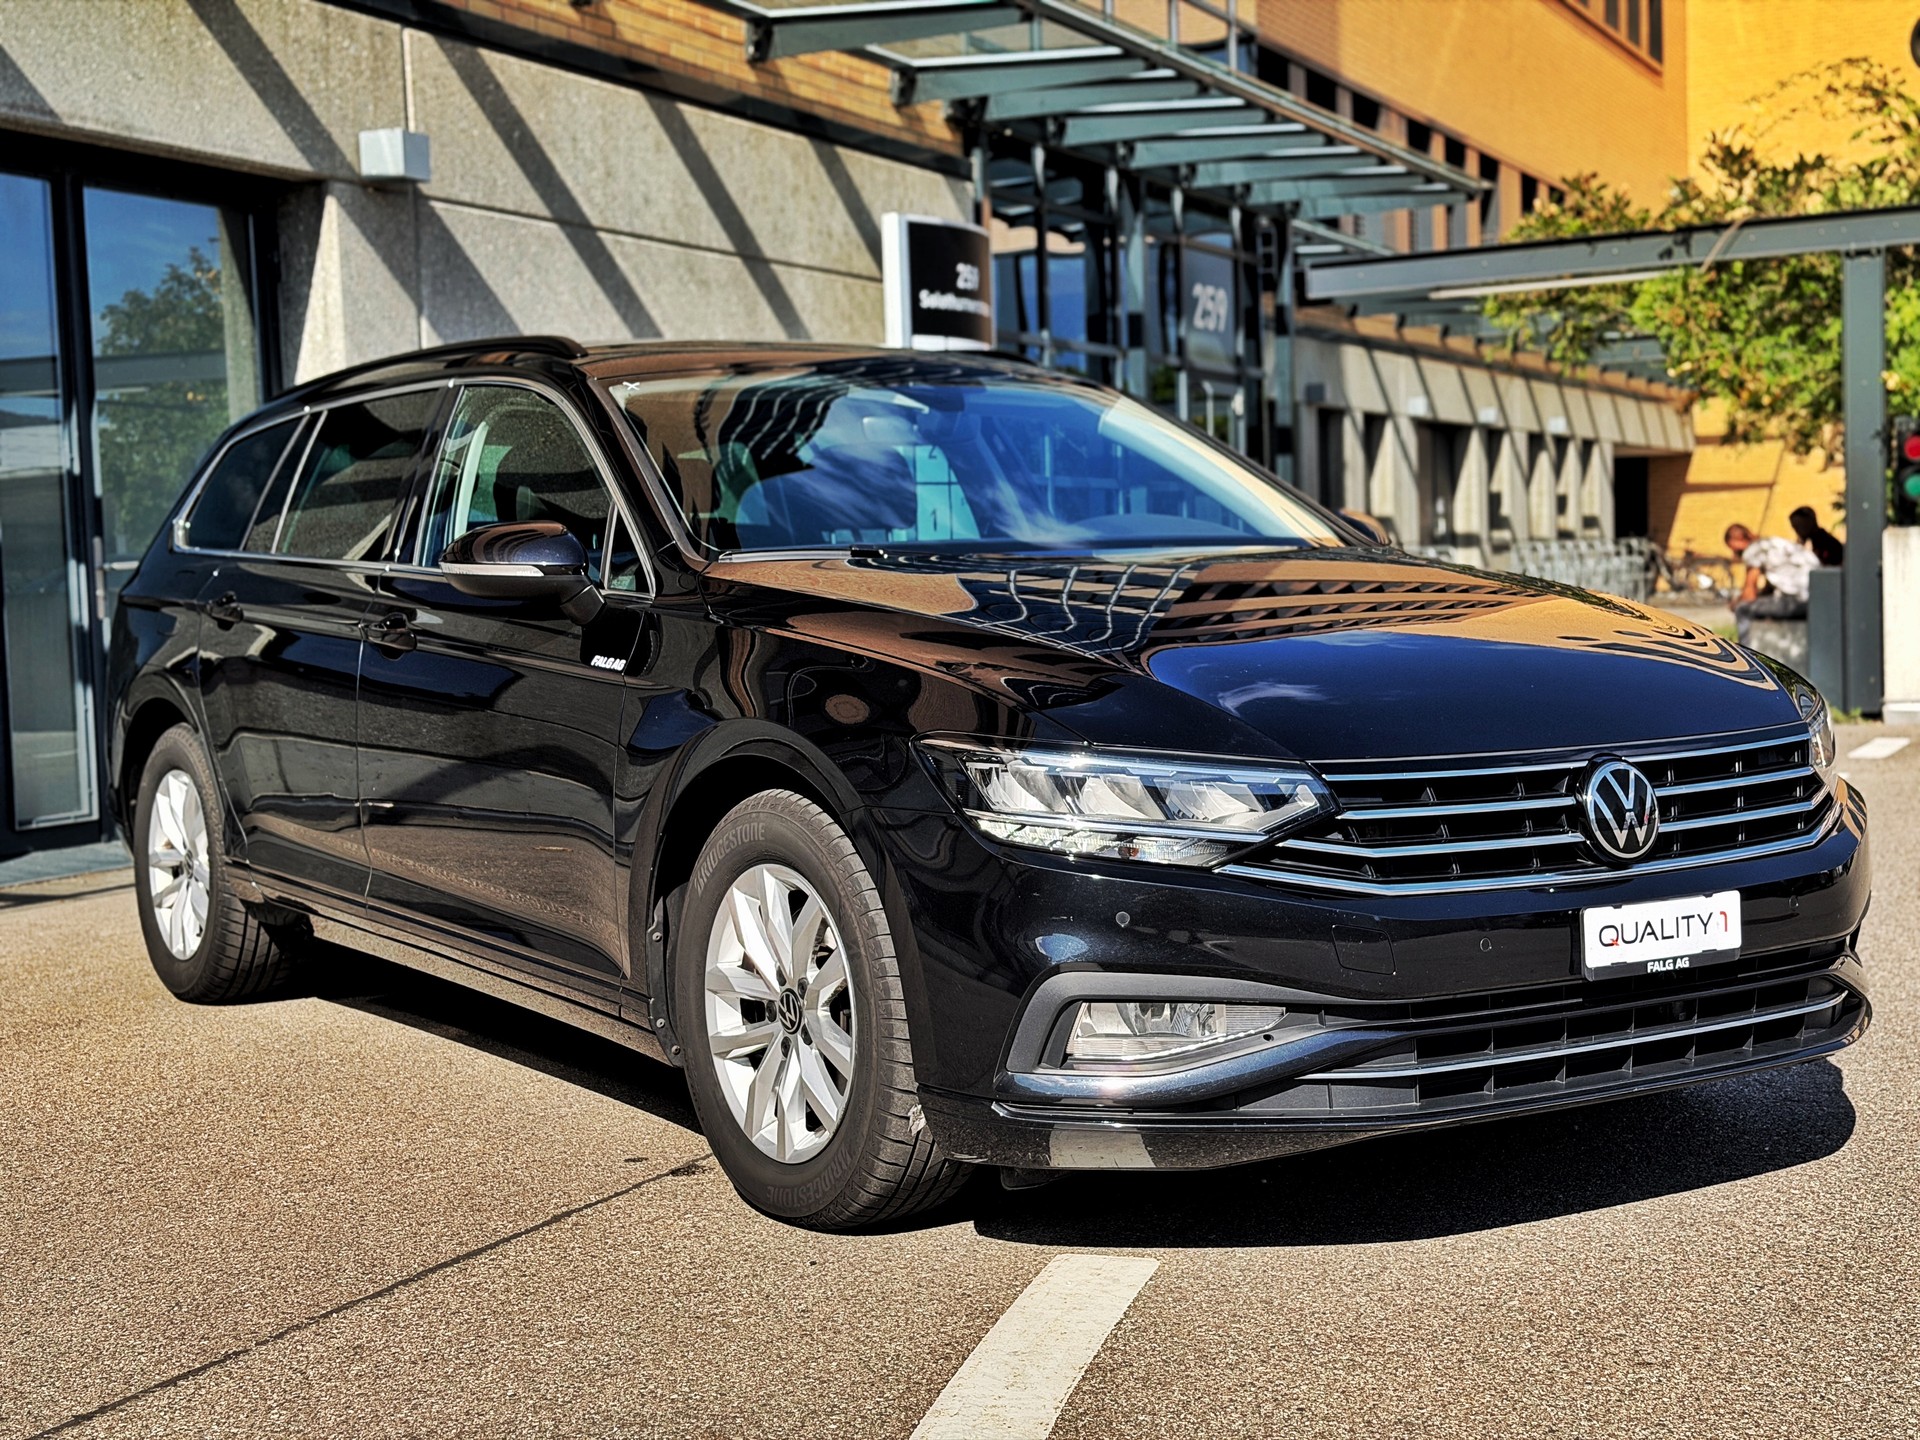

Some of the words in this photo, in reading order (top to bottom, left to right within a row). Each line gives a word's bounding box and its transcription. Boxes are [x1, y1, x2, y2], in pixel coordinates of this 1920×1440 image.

[1192, 282, 1228, 333] 259
[590, 654, 615, 669] FALG
[611, 658, 627, 671] AG
[1590, 763, 1655, 851] VW
[694, 822, 766, 897] BRIDGESTONE
[1599, 912, 1713, 947] QUALITY
[1719, 910, 1728, 932] 1
[1647, 959, 1674, 974] FALG
[1675, 956, 1690, 970] AG
